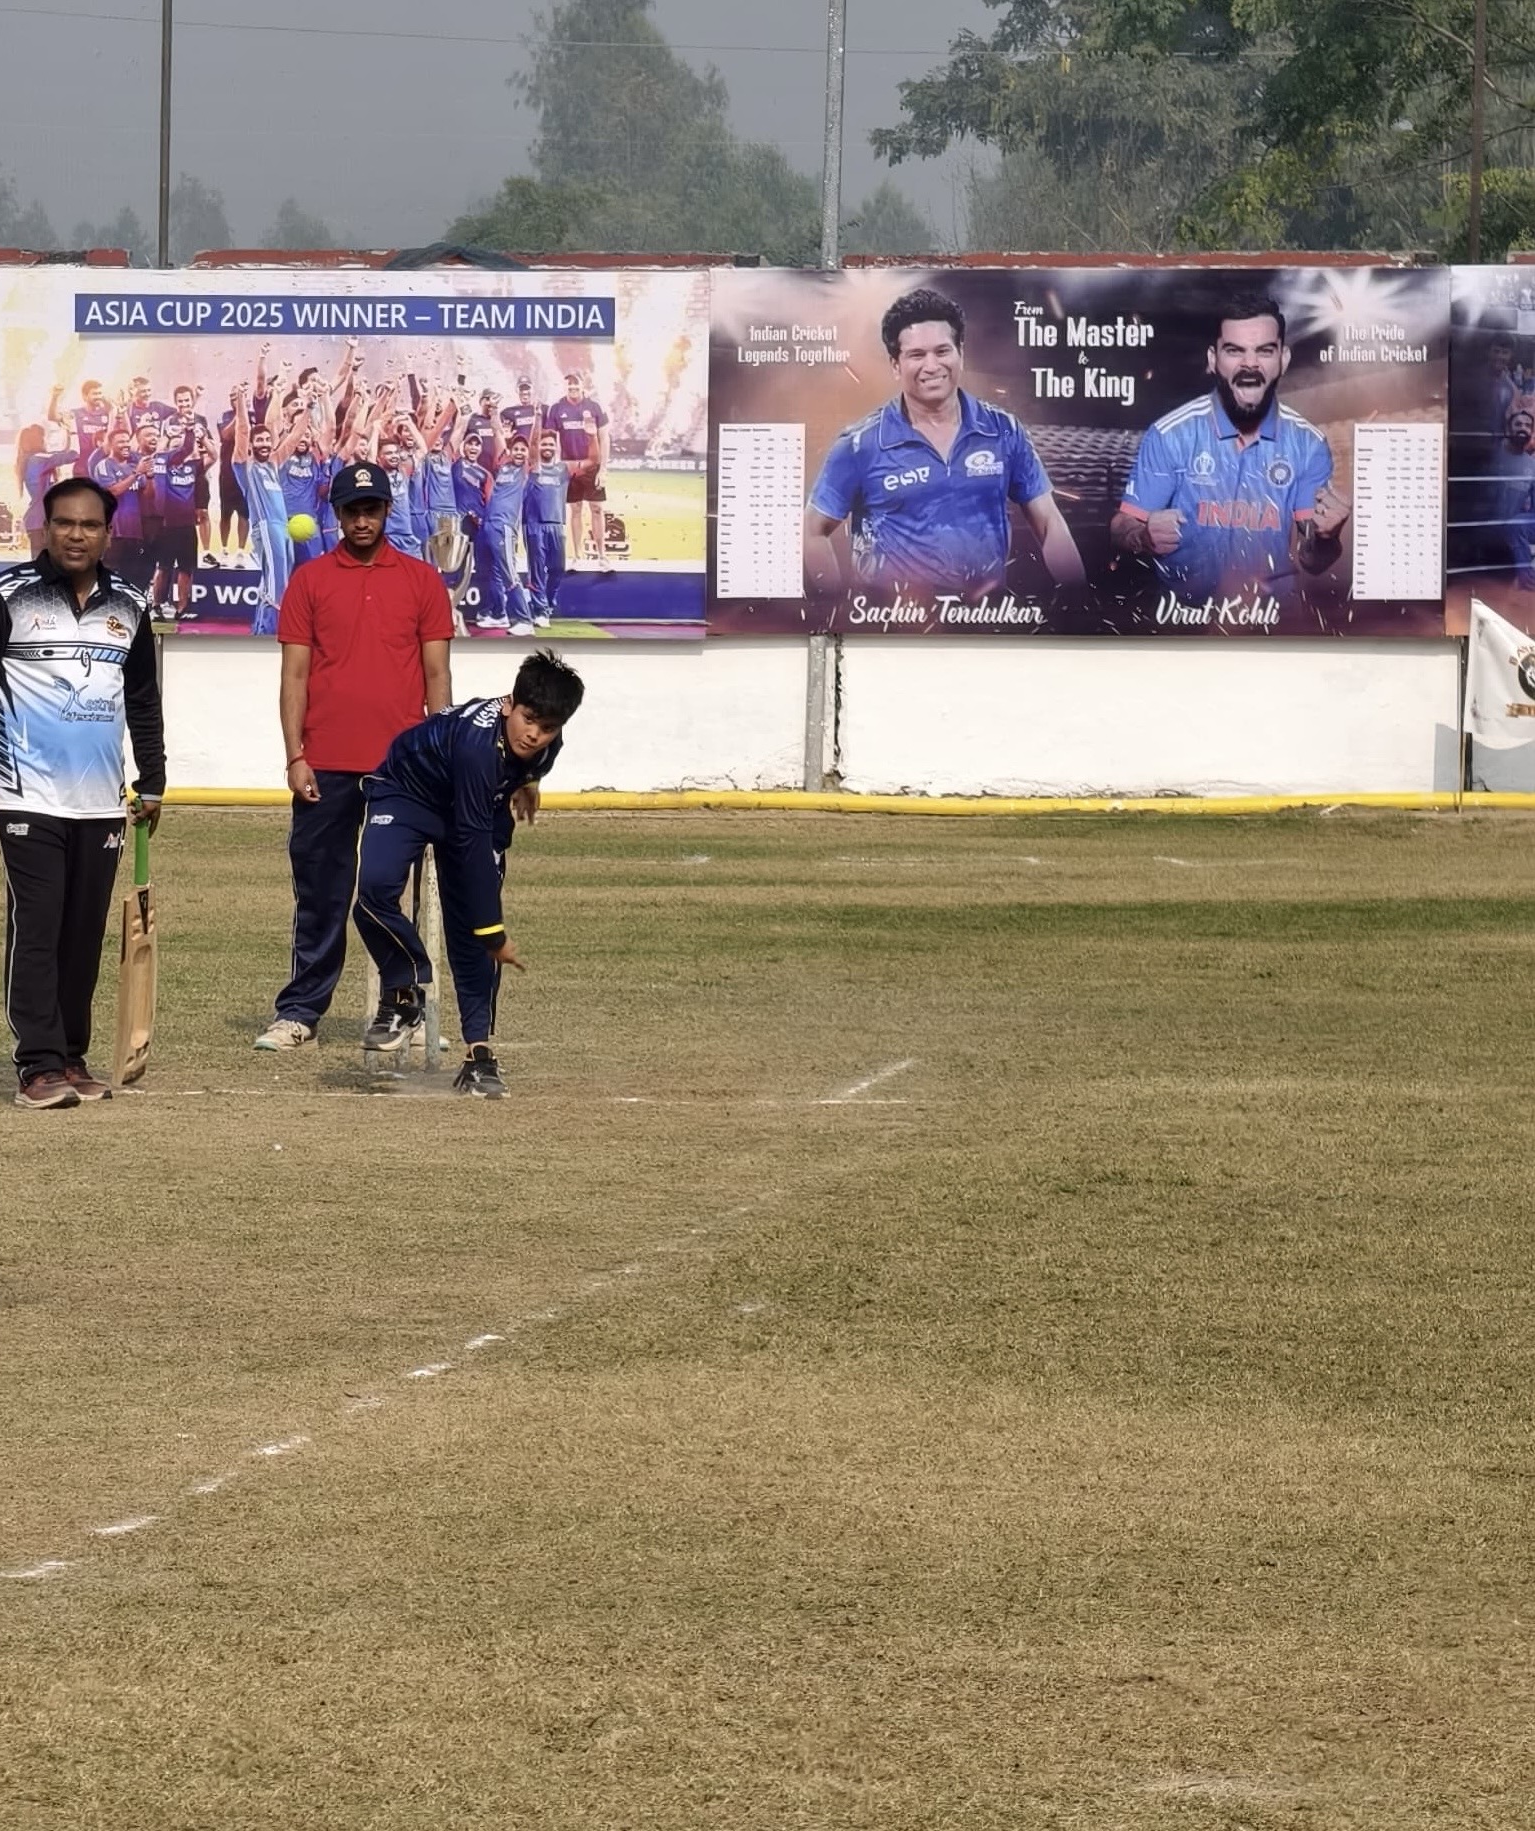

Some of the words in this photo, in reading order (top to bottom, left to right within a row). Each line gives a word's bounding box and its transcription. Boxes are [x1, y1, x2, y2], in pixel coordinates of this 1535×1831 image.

[84, 300, 149, 327] ASIA
[156, 301, 212, 327] CUP
[220, 302, 283, 328] 2025
[292, 302, 408, 329] WINNER
[438, 303, 515, 329] TEAM
[526, 304, 605, 330] INDIA
[1013, 300, 1044, 315] From
[749, 325, 787, 341] Indian
[791, 325, 837, 341] Cricket
[1014, 316, 1058, 347] The
[1066, 316, 1155, 347] Master
[1345, 325, 1367, 341] The
[1371, 324, 1405, 341] Pride
[737, 346, 789, 366] Legends
[793, 345, 850, 366] Together
[1077, 350, 1090, 365] to
[1319, 345, 1335, 362] of
[1338, 345, 1376, 362] Indian
[1380, 345, 1428, 362] Cricket
[1030, 367, 1075, 398] The
[1084, 367, 1135, 406] King
[1197, 500, 1281, 531] INDIA
[849, 595, 928, 625] Sachin
[935, 595, 1046, 625] Tendulkar
[1155, 590, 1214, 625] Virat
[1218, 595, 1281, 625] Kohli
